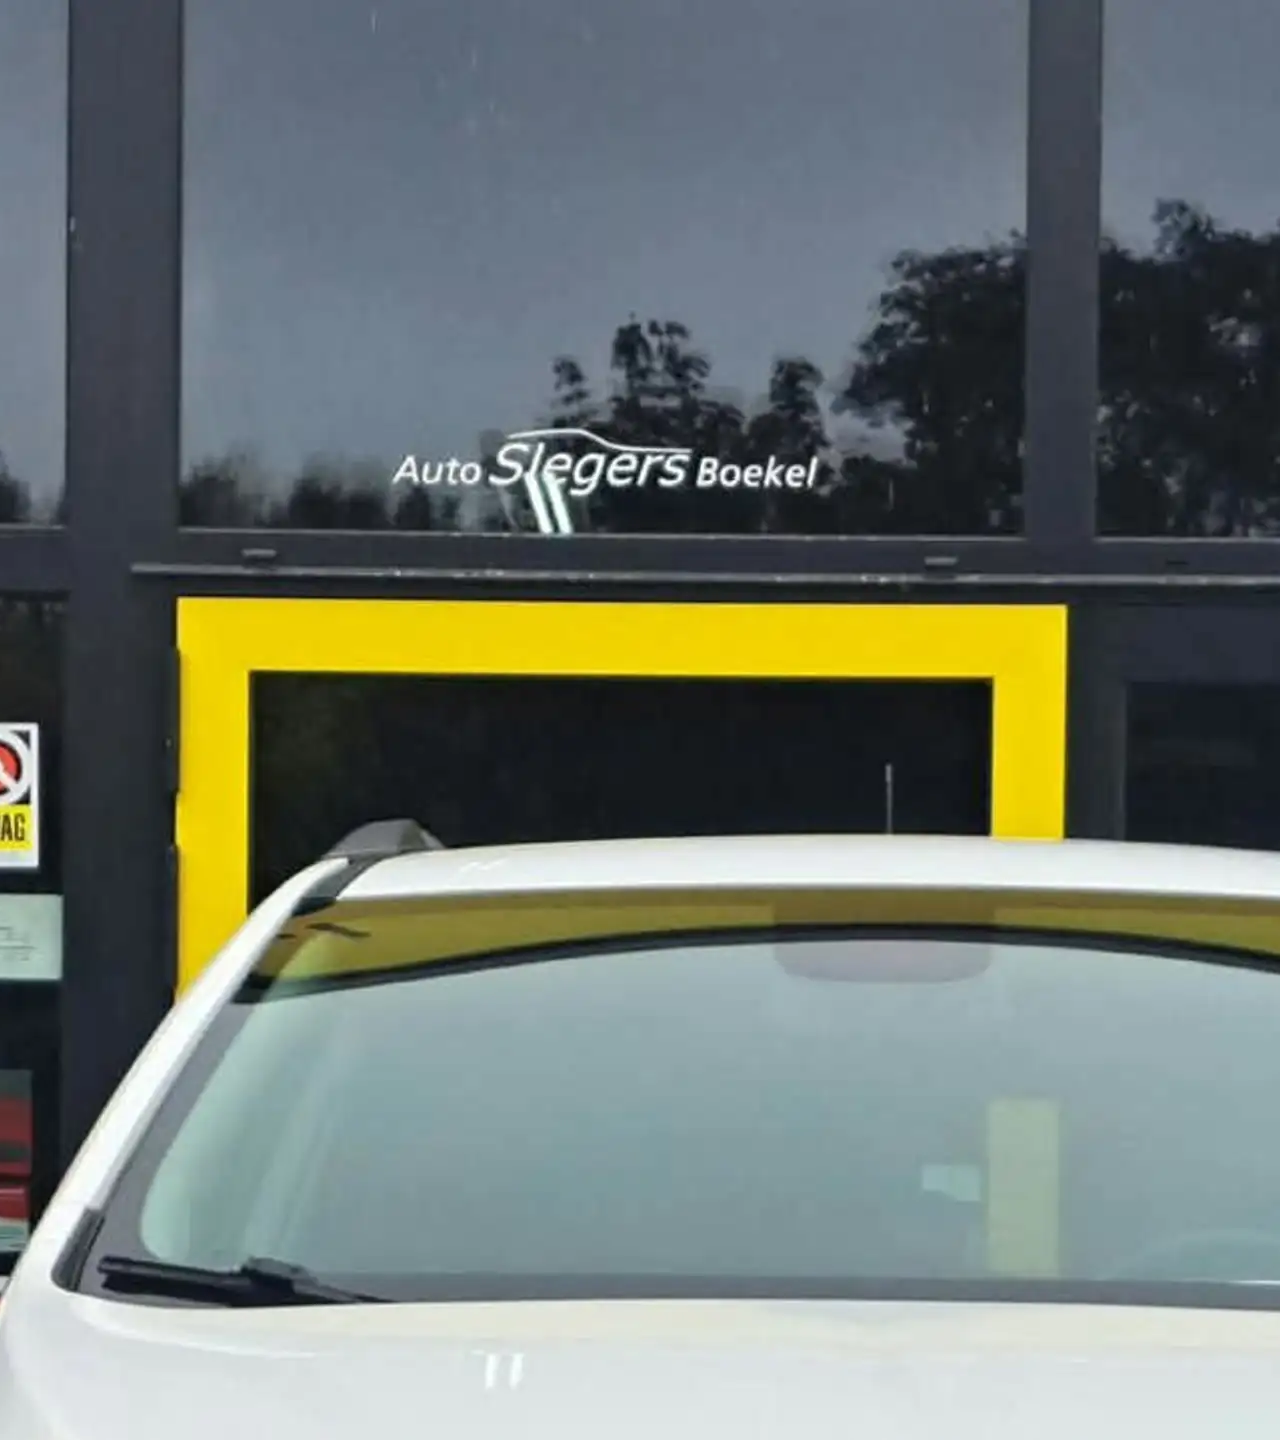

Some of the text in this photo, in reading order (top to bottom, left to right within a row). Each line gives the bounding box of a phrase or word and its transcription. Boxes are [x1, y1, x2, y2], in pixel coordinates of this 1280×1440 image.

[392, 441, 818, 496] Auto Slegers Boekel
